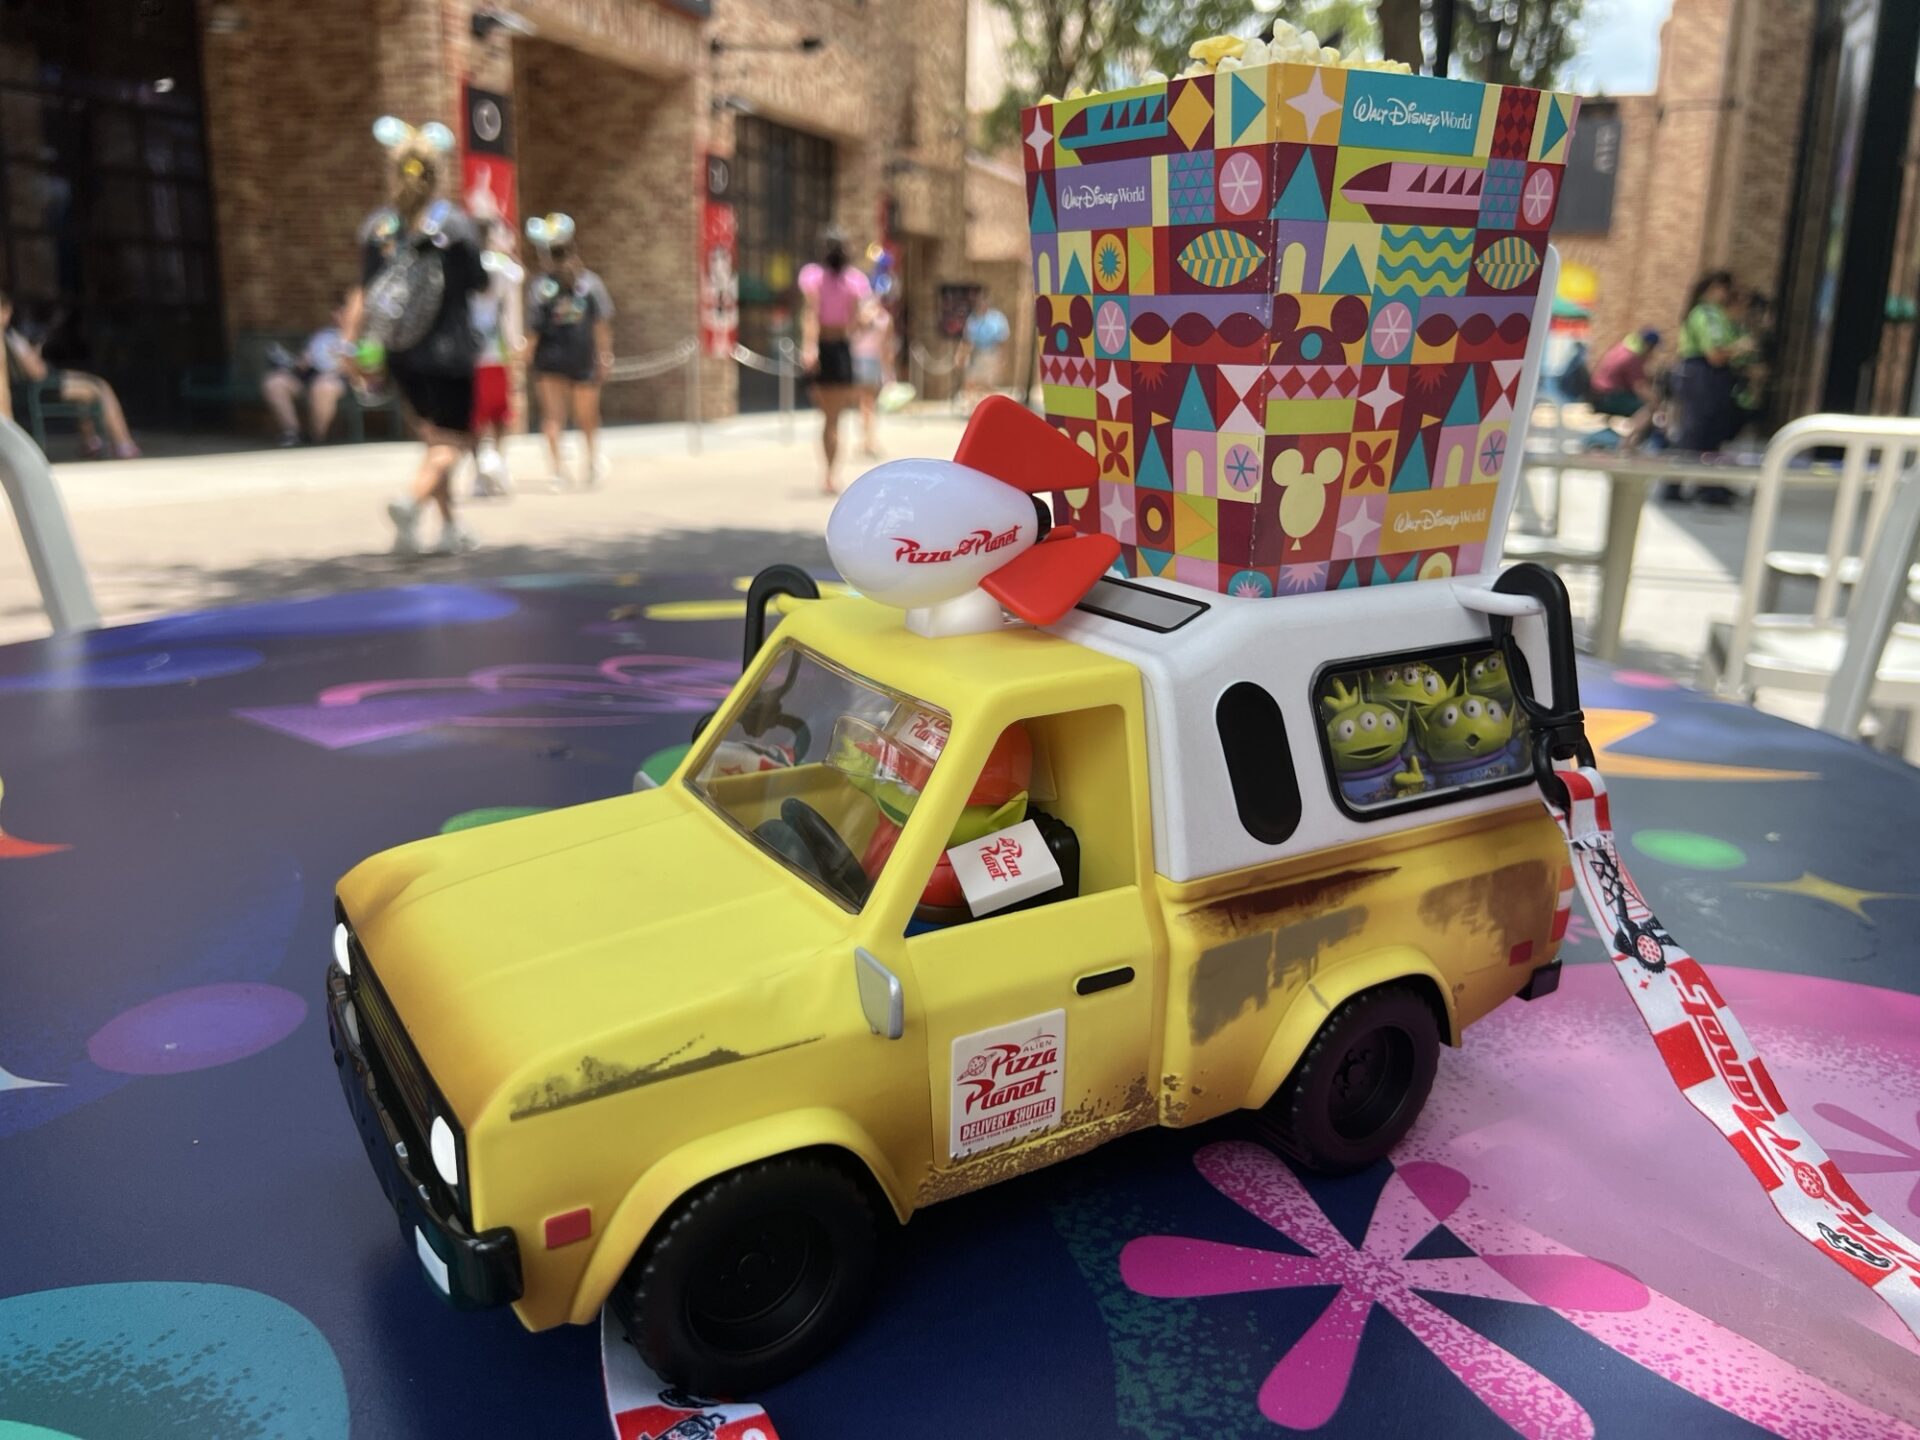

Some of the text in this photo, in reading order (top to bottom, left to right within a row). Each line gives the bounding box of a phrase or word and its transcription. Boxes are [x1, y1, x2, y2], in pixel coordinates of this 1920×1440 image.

[1353, 94, 1473, 133] Walt Disney World
[1080, 185, 1118, 211] Disney
[1117, 186, 1145, 203] World
[890, 525, 1022, 563] Pizza Planet
[979, 841, 1007, 881] Planet
[1000, 843, 1022, 877] Pizza
[984, 1044, 1058, 1080] Pizza
[1022, 1039, 1053, 1054] ALIEN
[958, 1070, 1058, 1115] Planet
[1675, 976, 1801, 1178] Planet
[961, 1110, 1012, 1141] DELIVERY
[1013, 1098, 1055, 1124] SHUTTLE
